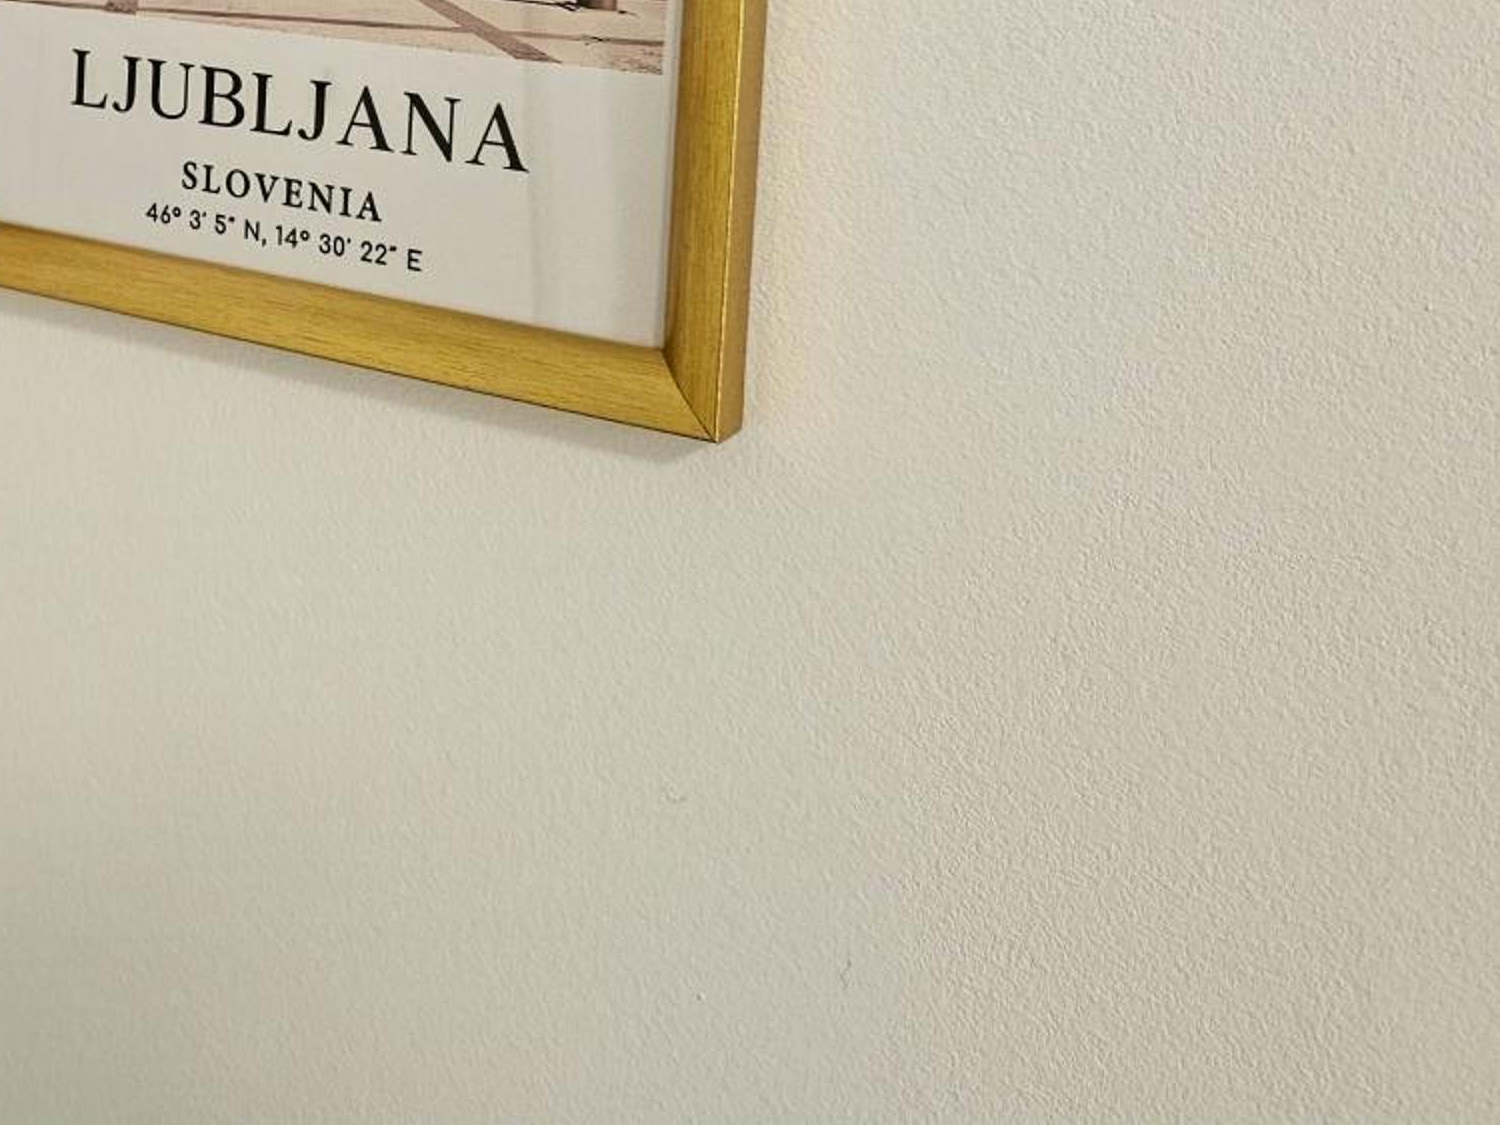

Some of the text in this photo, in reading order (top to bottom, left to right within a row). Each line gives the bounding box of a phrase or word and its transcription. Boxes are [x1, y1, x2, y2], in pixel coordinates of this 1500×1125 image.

[70, 48, 530, 174] LJUBLJANA
[181, 160, 383, 223] SLOVENIA
[188, 208, 207, 230] 3'
[243, 218, 268, 248] N,
[319, 233, 351, 257] 30'
[360, 240, 397, 266] 22"
[407, 248, 423, 272] E
